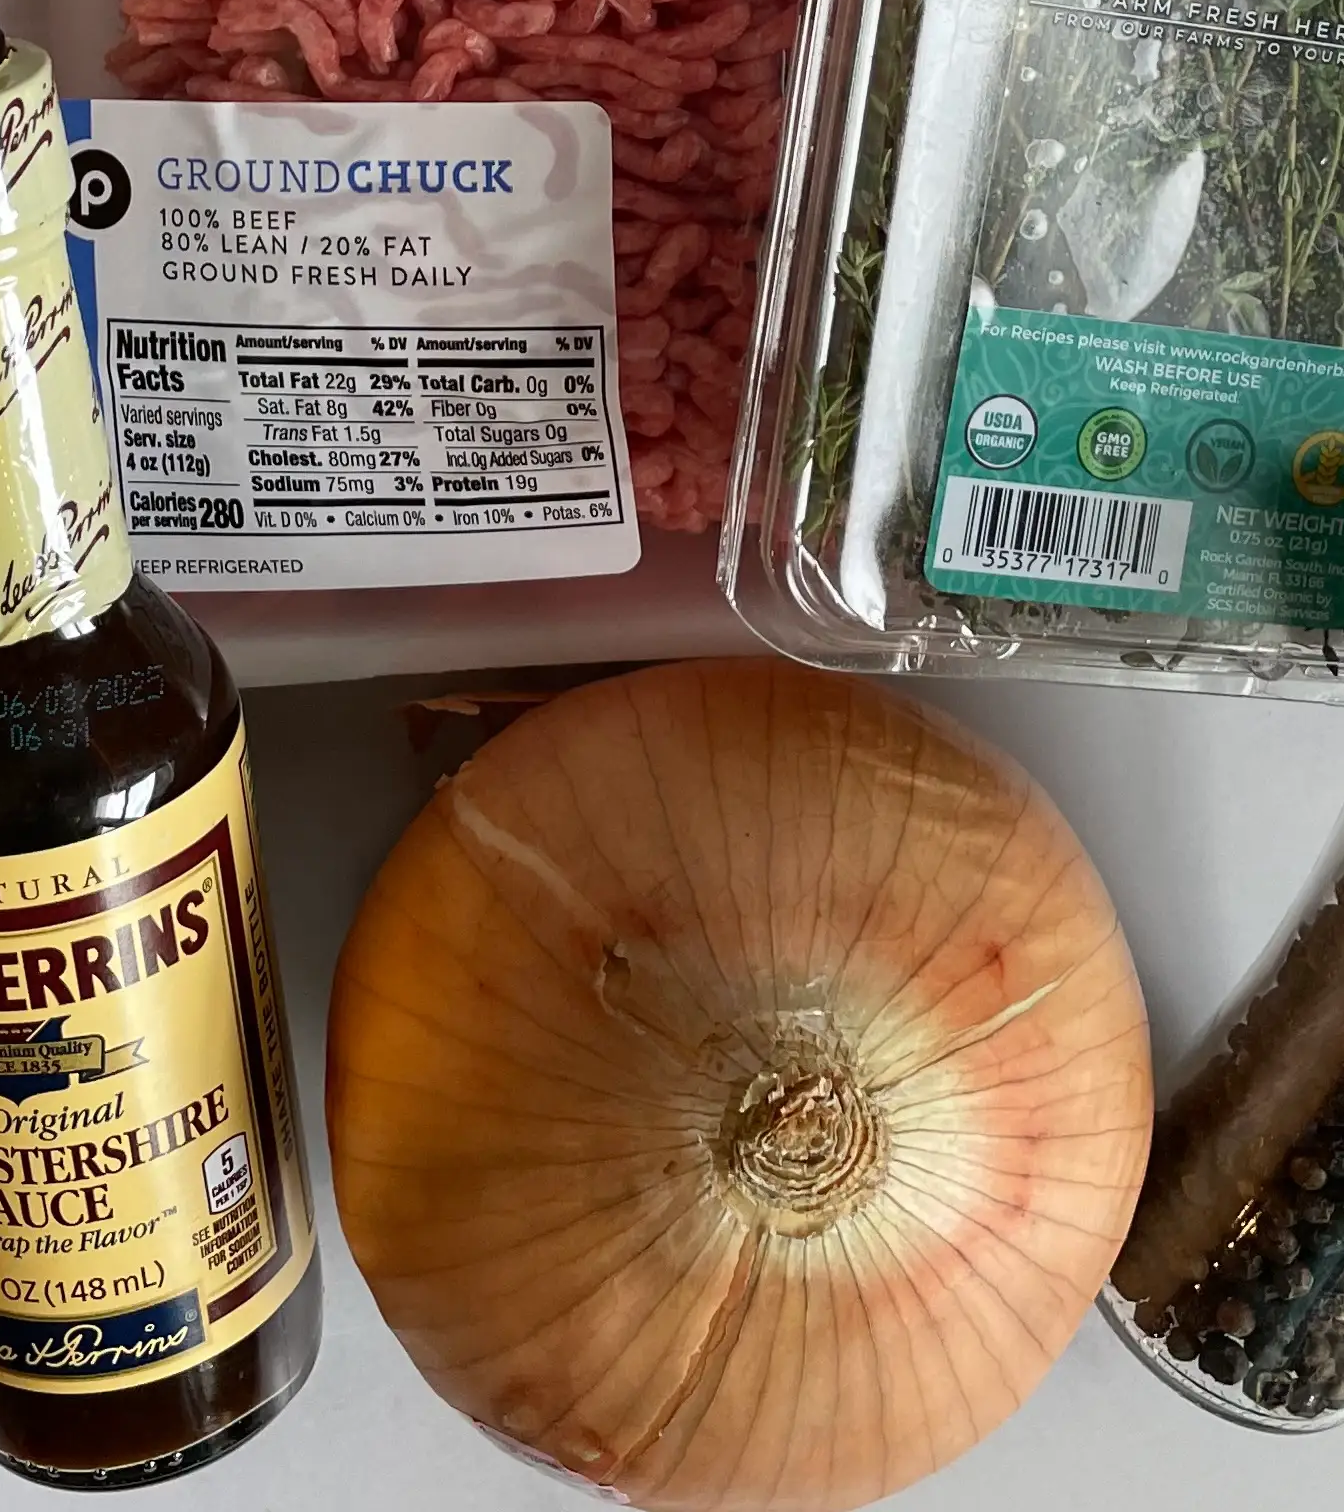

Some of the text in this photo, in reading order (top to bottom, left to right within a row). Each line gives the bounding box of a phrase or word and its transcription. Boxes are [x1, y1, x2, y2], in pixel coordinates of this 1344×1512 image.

[1187, 2, 1280, 31] FRESH
[1053, 12, 1112, 32] FROM
[1121, 20, 1165, 41] OUR
[1174, 28, 1245, 52] FARMS
[158, 209, 297, 231] 100% BEEF
[161, 233, 432, 257] 80% LEAN 20% FAT
[162, 262, 472, 287] GROUND FRESH DAILY
[116, 329, 226, 362] Nutrition
[236, 335, 343, 351] Amount/serving
[416, 337, 527, 353] Amount/serving
[979, 321, 1006, 337] For
[1011, 325, 1075, 347] Recipes
[1077, 333, 1130, 353] please
[1132, 337, 1166, 357] visit
[117, 363, 185, 392] Facts
[238, 371, 411, 390] Total Fat 29%
[1095, 356, 1262, 389] WASH BEFORE USE
[418, 375, 595, 393] Total Carb. 0%
[1109, 377, 1147, 396] Keep
[372, 400, 414, 416] 42%
[431, 401, 471, 417] Fiber
[983, 411, 1024, 432] USDA
[263, 424, 307, 441] Trans
[434, 425, 540, 445] Total Sugars
[974, 433, 1025, 452] ORGANIC
[1096, 431, 1131, 447] GMO
[248, 450, 420, 471] Cholest. 80mg 27%
[1094, 443, 1130, 459] FREE
[251, 475, 375, 495] Sodium 75mg
[431, 475, 499, 492] Protein
[130, 491, 244, 529] Calories 280
[345, 511, 399, 527] Calcium
[1217, 506, 1261, 527] NET
[1230, 530, 1329, 555] 0.75 (21g)
[176, 560, 303, 574] REFRIGERATED
[980, 549, 1131, 582] 35377 17317
[1235, 553, 1282, 569] Garden
[37, 1041, 92, 1060] Quality
[21, 1060, 62, 1074] 1835
[221, 1148, 234, 1176] 5
[35, 1229, 73, 1254] the
[200, 1208, 258, 1258] INFORMATION
[226, 1236, 262, 1275] CONTENT
[1, 1277, 40, 1304] OZ
[43, 1271, 107, 1308] (148
[114, 1260, 167, 1298] mL)
